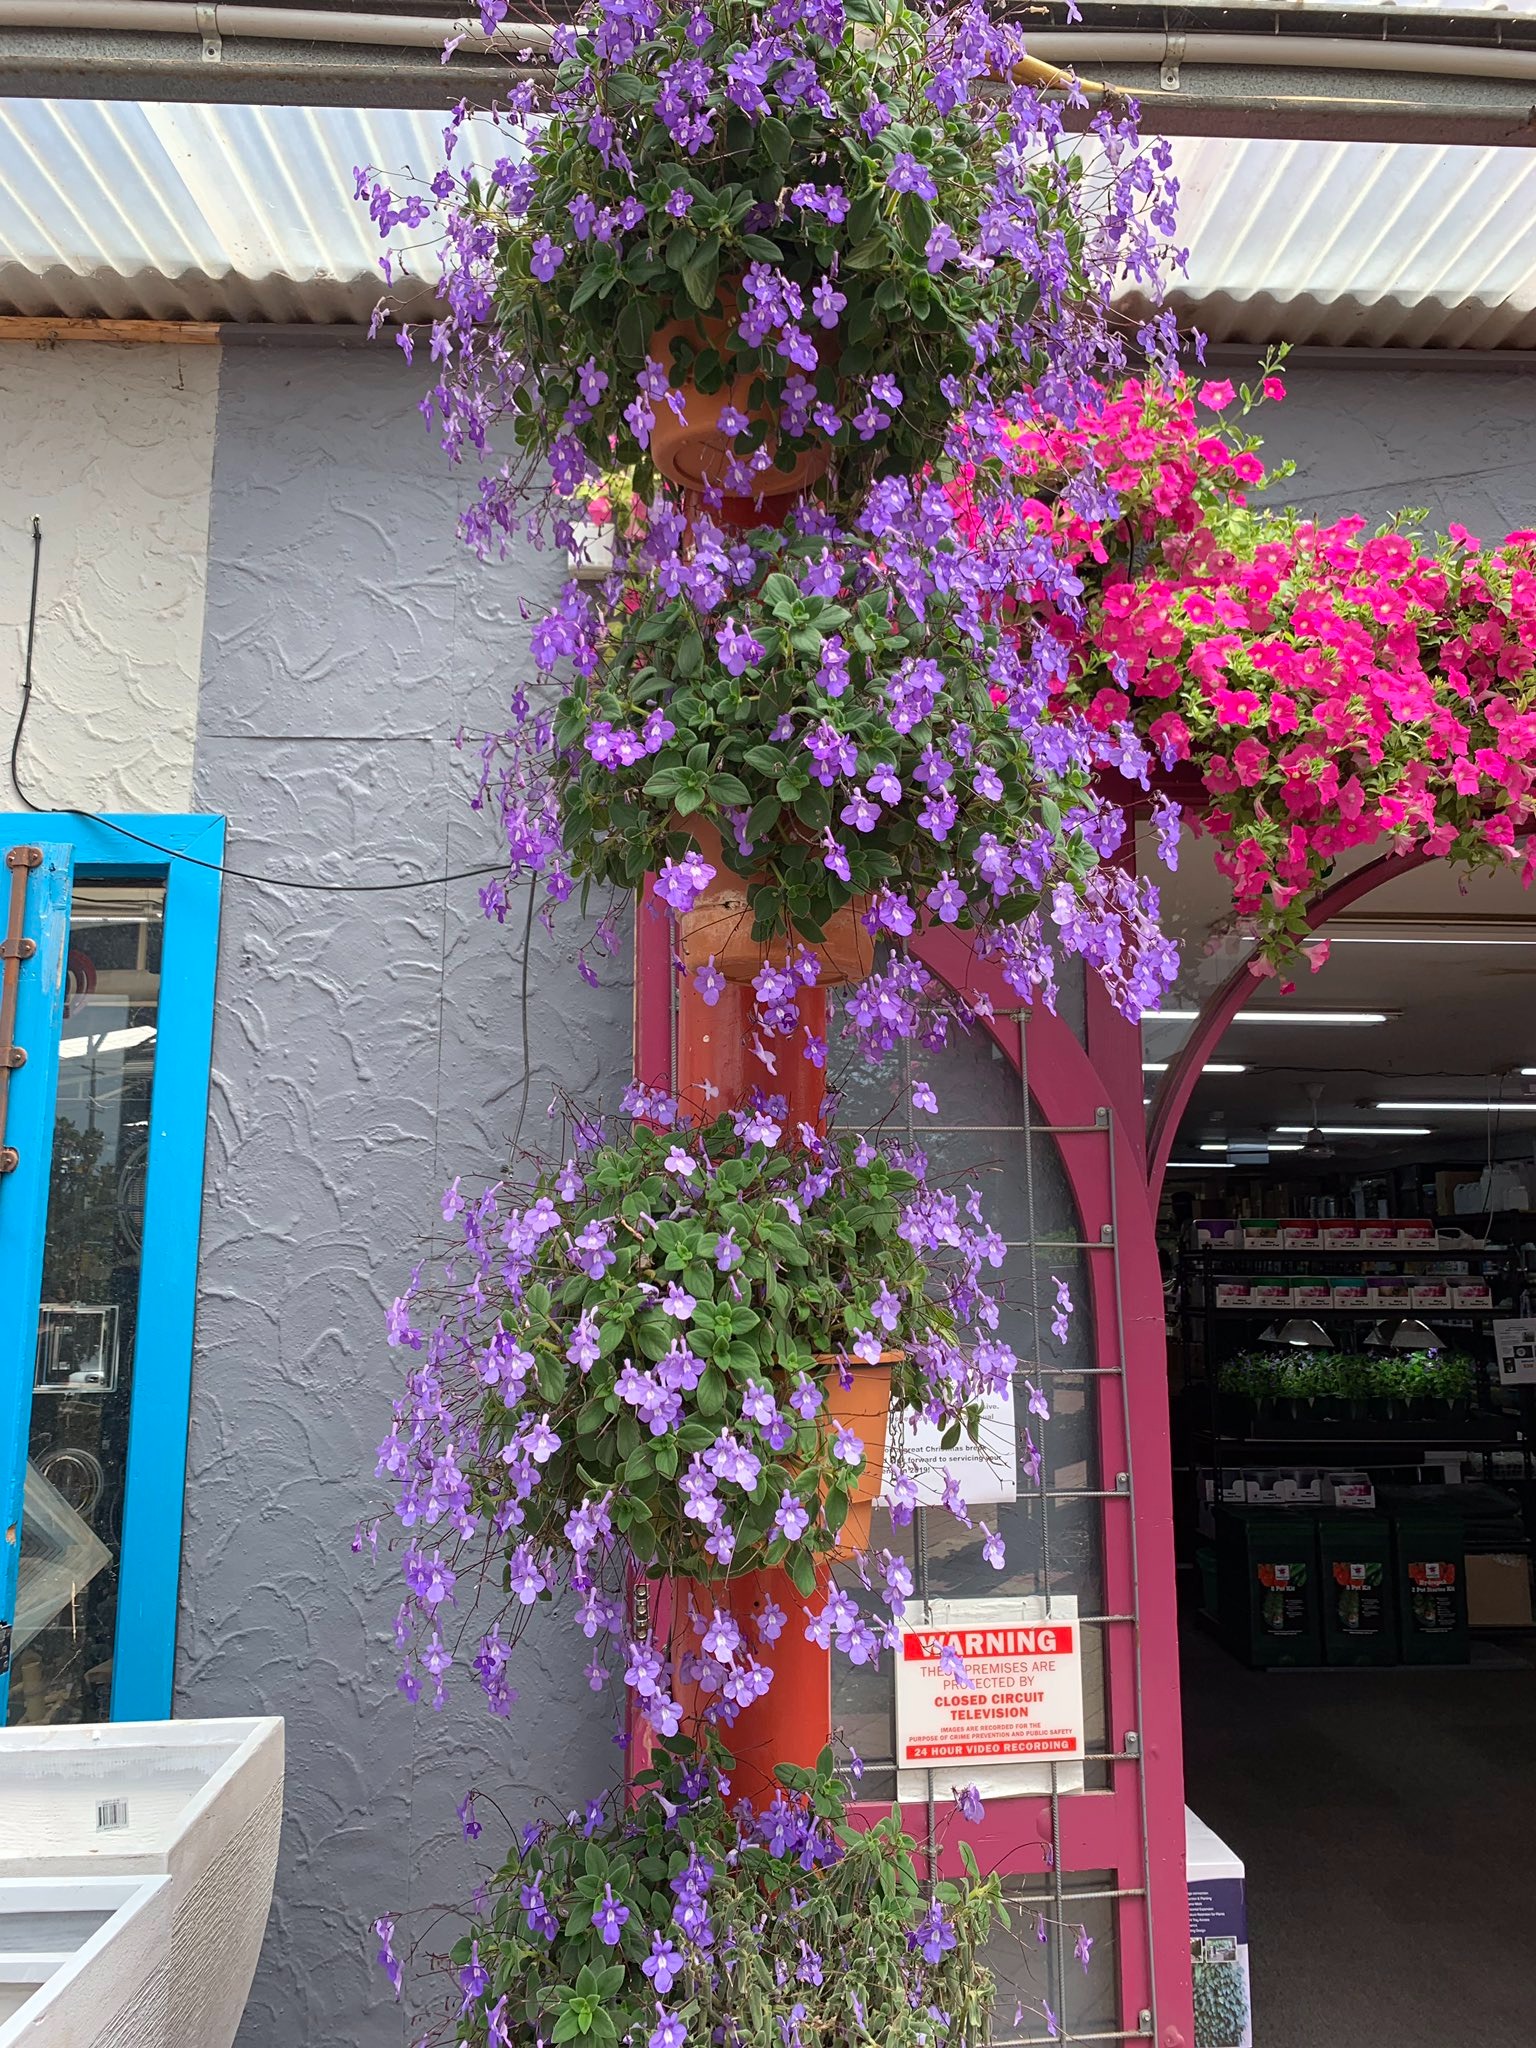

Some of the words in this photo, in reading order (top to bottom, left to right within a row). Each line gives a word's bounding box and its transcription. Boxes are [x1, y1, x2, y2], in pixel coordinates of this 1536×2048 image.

[925, 1445, 964, 1453] Chrimas
[949, 1455, 984, 1463] servicing
[919, 1630, 1057, 1657] WARNING
[920, 1665, 955, 1678] THE
[965, 1661, 1028, 1675] PREMISES
[1032, 1660, 1056, 1673] ARE
[943, 1677, 1015, 1690] PROECTED
[1022, 1675, 1035, 1687] BY
[934, 1694, 987, 1708] CLOSED
[991, 1692, 1044, 1705] CIRCUIT
[951, 1707, 1028, 1720] TELEVISION
[909, 1735, 938, 1743] PURPOSE
[950, 1733, 970, 1741] CRIME
[972, 1731, 1010, 1739] PREVENTION
[1011, 1730, 1025, 1738] AND
[1026, 1729, 1049, 1737] PUBLIC
[1050, 1728, 1073, 1736] SAFETY
[940, 1726, 964, 1734] IMAGES
[980, 1724, 1014, 1732] RECORDED
[914, 1747, 928, 1757] 24
[931, 1745, 963, 1756] HOUR
[966, 1743, 1001, 1754] VIDEO
[1003, 1741, 1070, 1753] RECORDING
